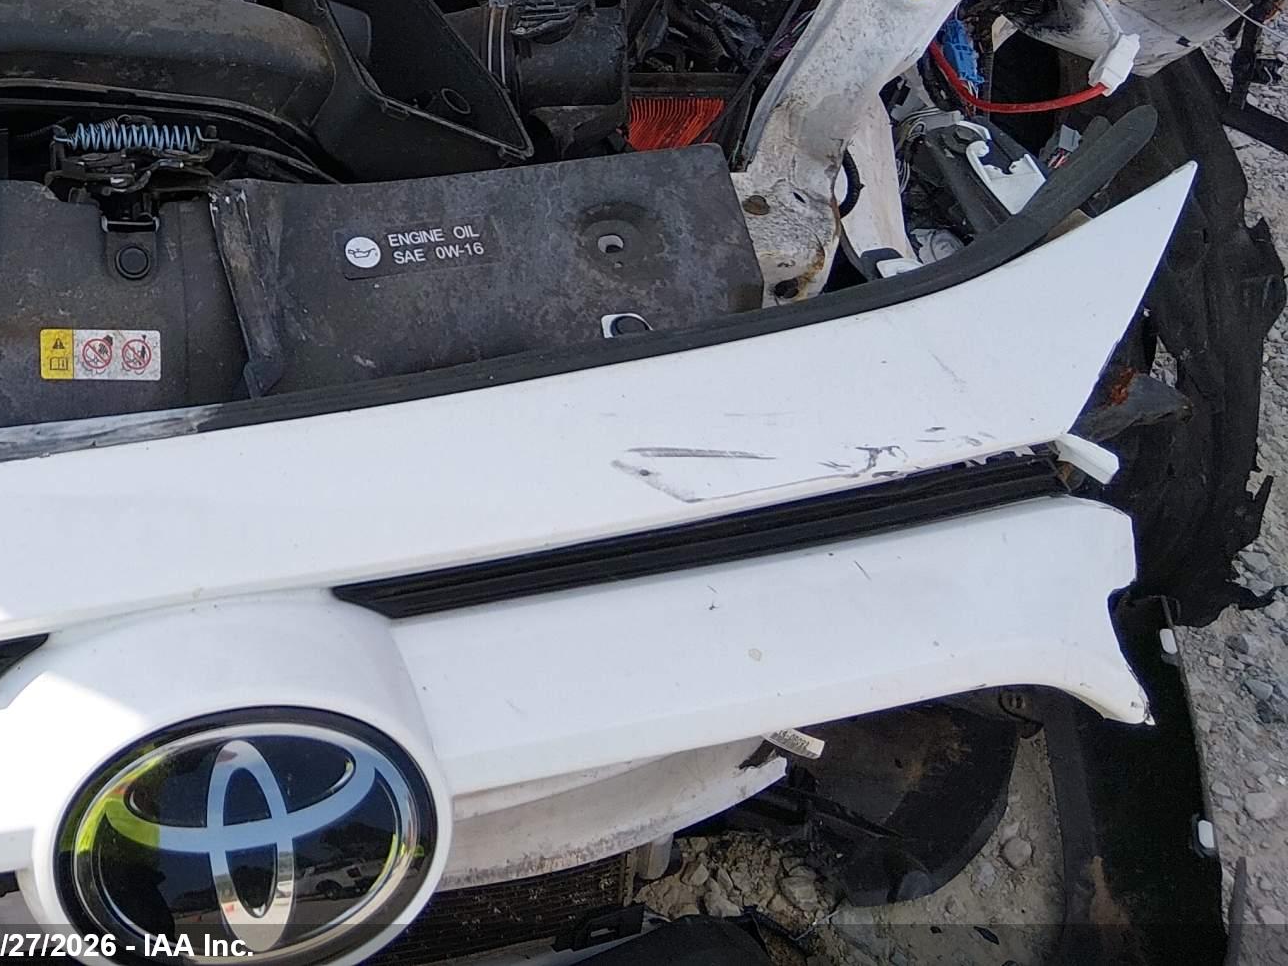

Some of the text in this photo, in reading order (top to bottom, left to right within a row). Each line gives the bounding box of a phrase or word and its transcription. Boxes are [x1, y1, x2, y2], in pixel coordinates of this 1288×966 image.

[387, 225, 480, 247] ENGINE OIL
[393, 242, 484, 264] SAE 0W-16
